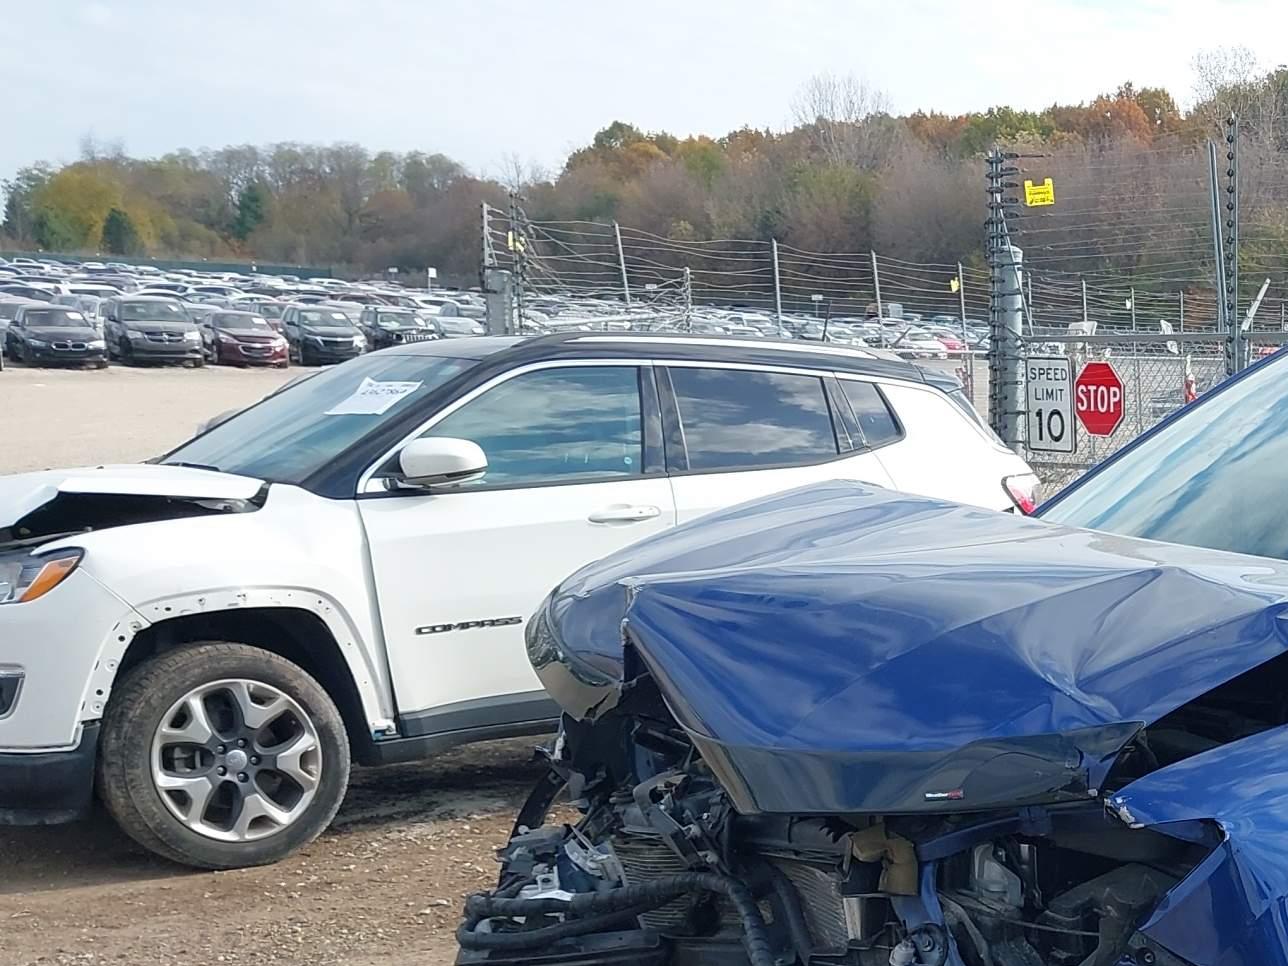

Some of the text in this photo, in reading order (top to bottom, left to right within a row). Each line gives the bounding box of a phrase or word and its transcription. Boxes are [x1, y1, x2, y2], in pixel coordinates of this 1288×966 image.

[1029, 367, 1068, 381] SPEED
[1034, 388, 1065, 402] LIMIT
[1077, 384, 1121, 413] STOP
[1035, 408, 1065, 443] 10
[415, 616, 523, 635] COMPASS
